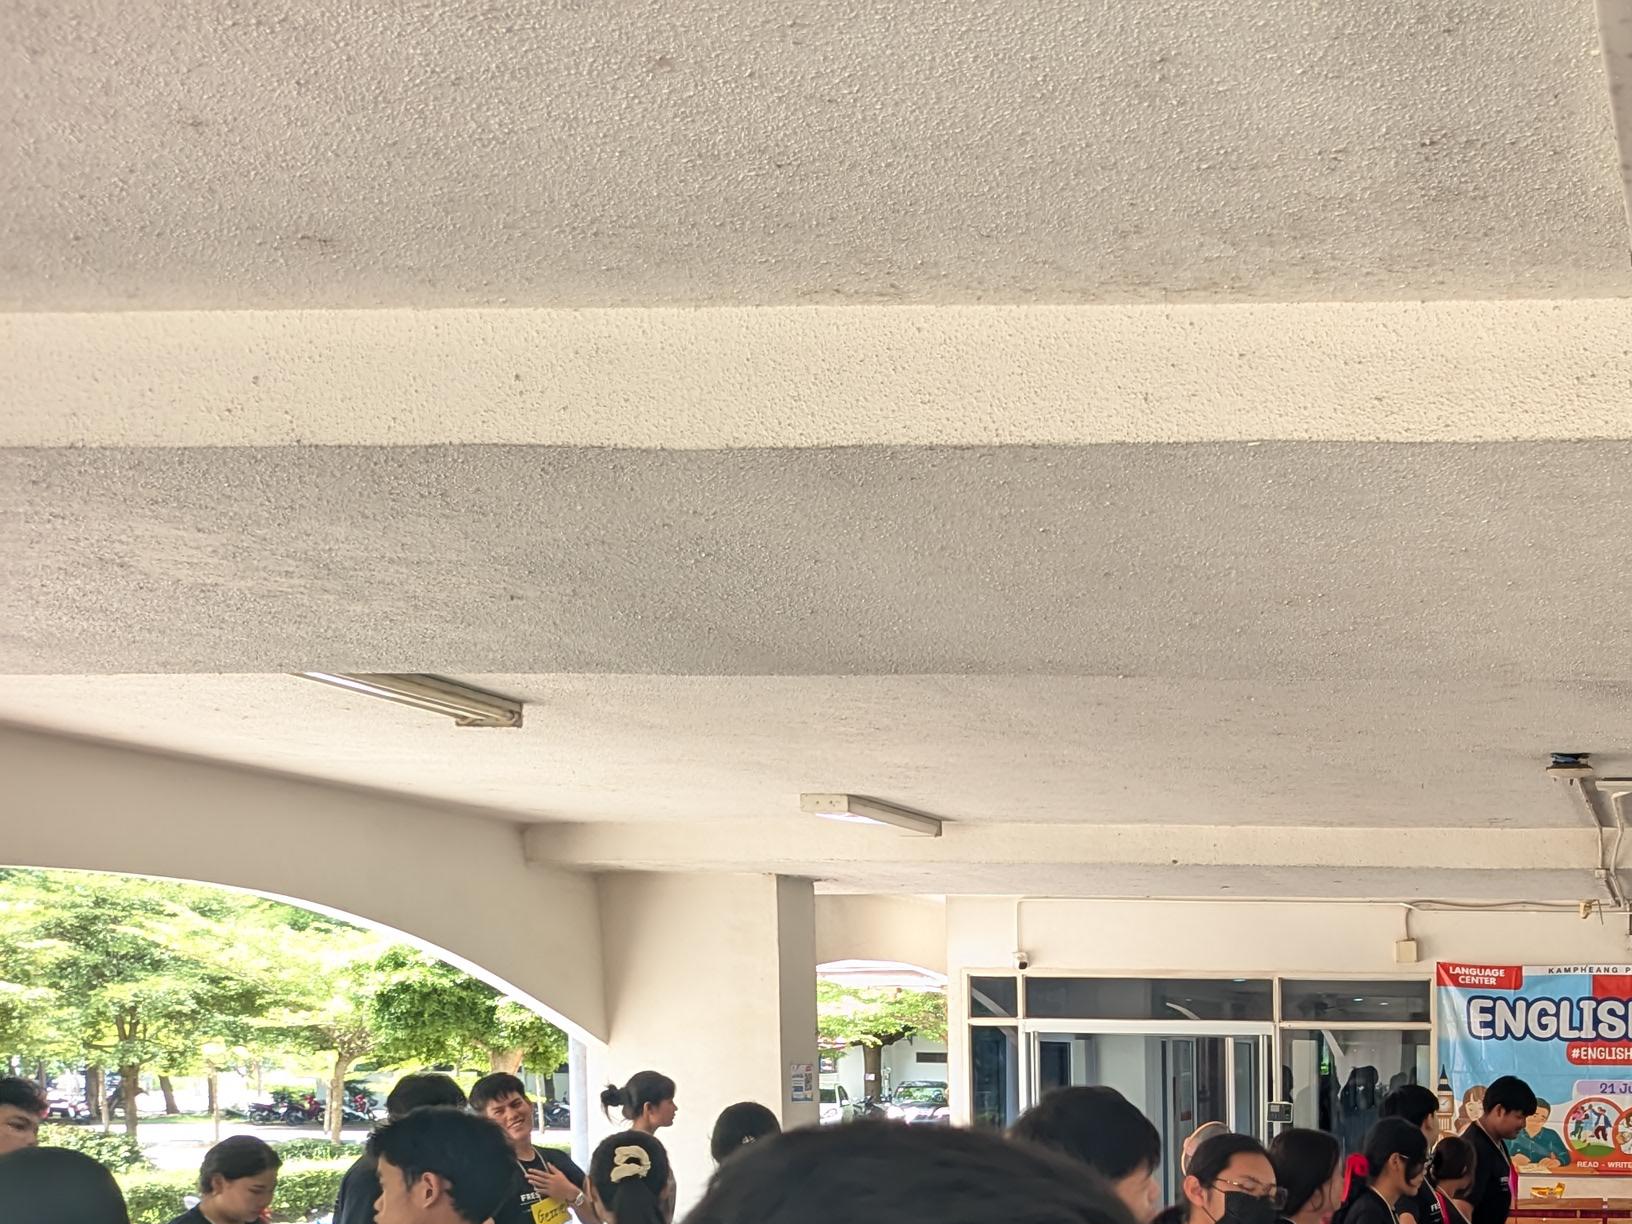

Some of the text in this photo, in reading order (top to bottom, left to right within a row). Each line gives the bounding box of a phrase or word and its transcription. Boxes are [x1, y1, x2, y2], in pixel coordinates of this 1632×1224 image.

[1449, 966, 1505, 977] LANGUAGE
[1548, 966, 1619, 974] KAMPHEANG
[1458, 975, 1497, 985] CENTER
[1600, 1083, 1615, 1094] 21
[1607, 1161, 1632, 1169] WRITE
[520, 1192, 541, 1202] FRES
